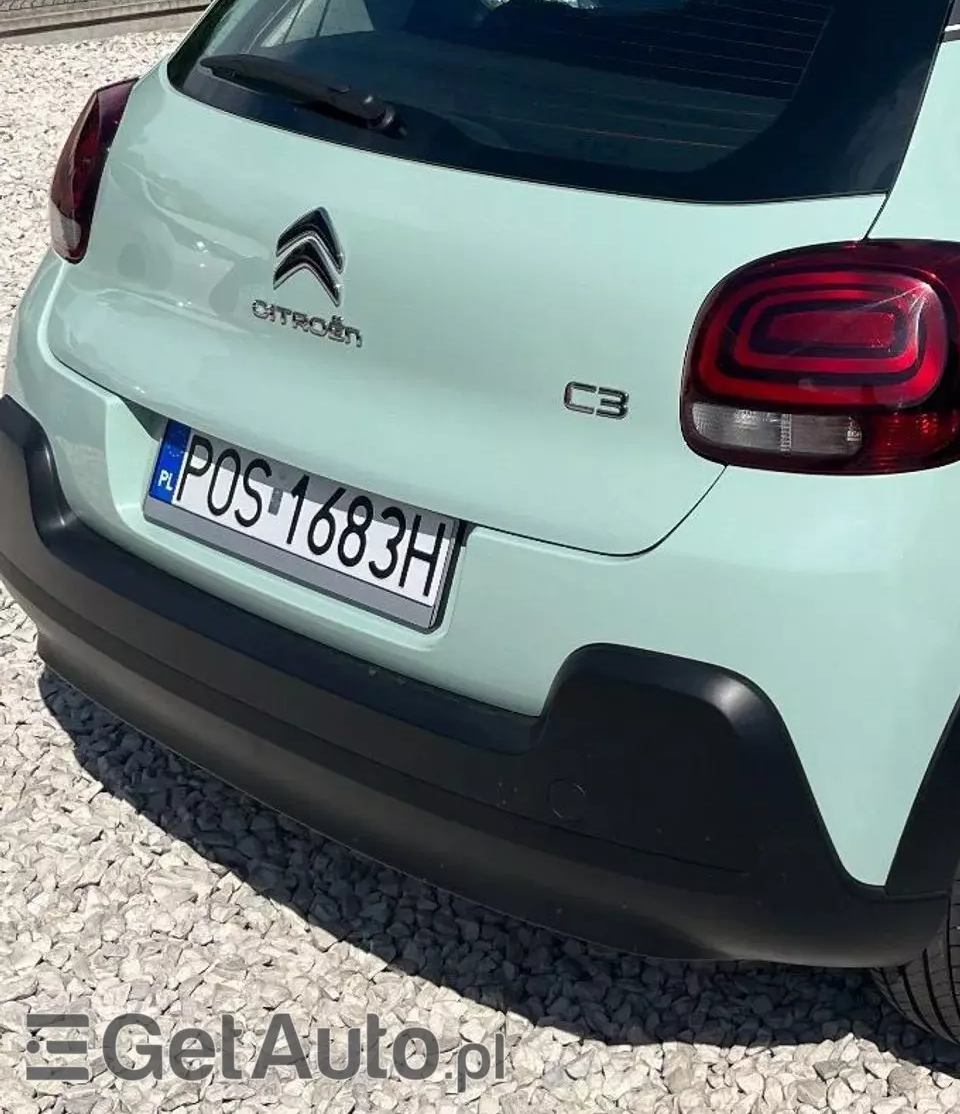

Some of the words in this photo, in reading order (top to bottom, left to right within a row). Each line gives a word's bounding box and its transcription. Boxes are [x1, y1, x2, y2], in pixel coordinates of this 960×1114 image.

[563, 381, 630, 420] C3
[158, 469, 174, 492] PL
[176, 434, 273, 528] POS
[286, 474, 447, 598] 1683H
